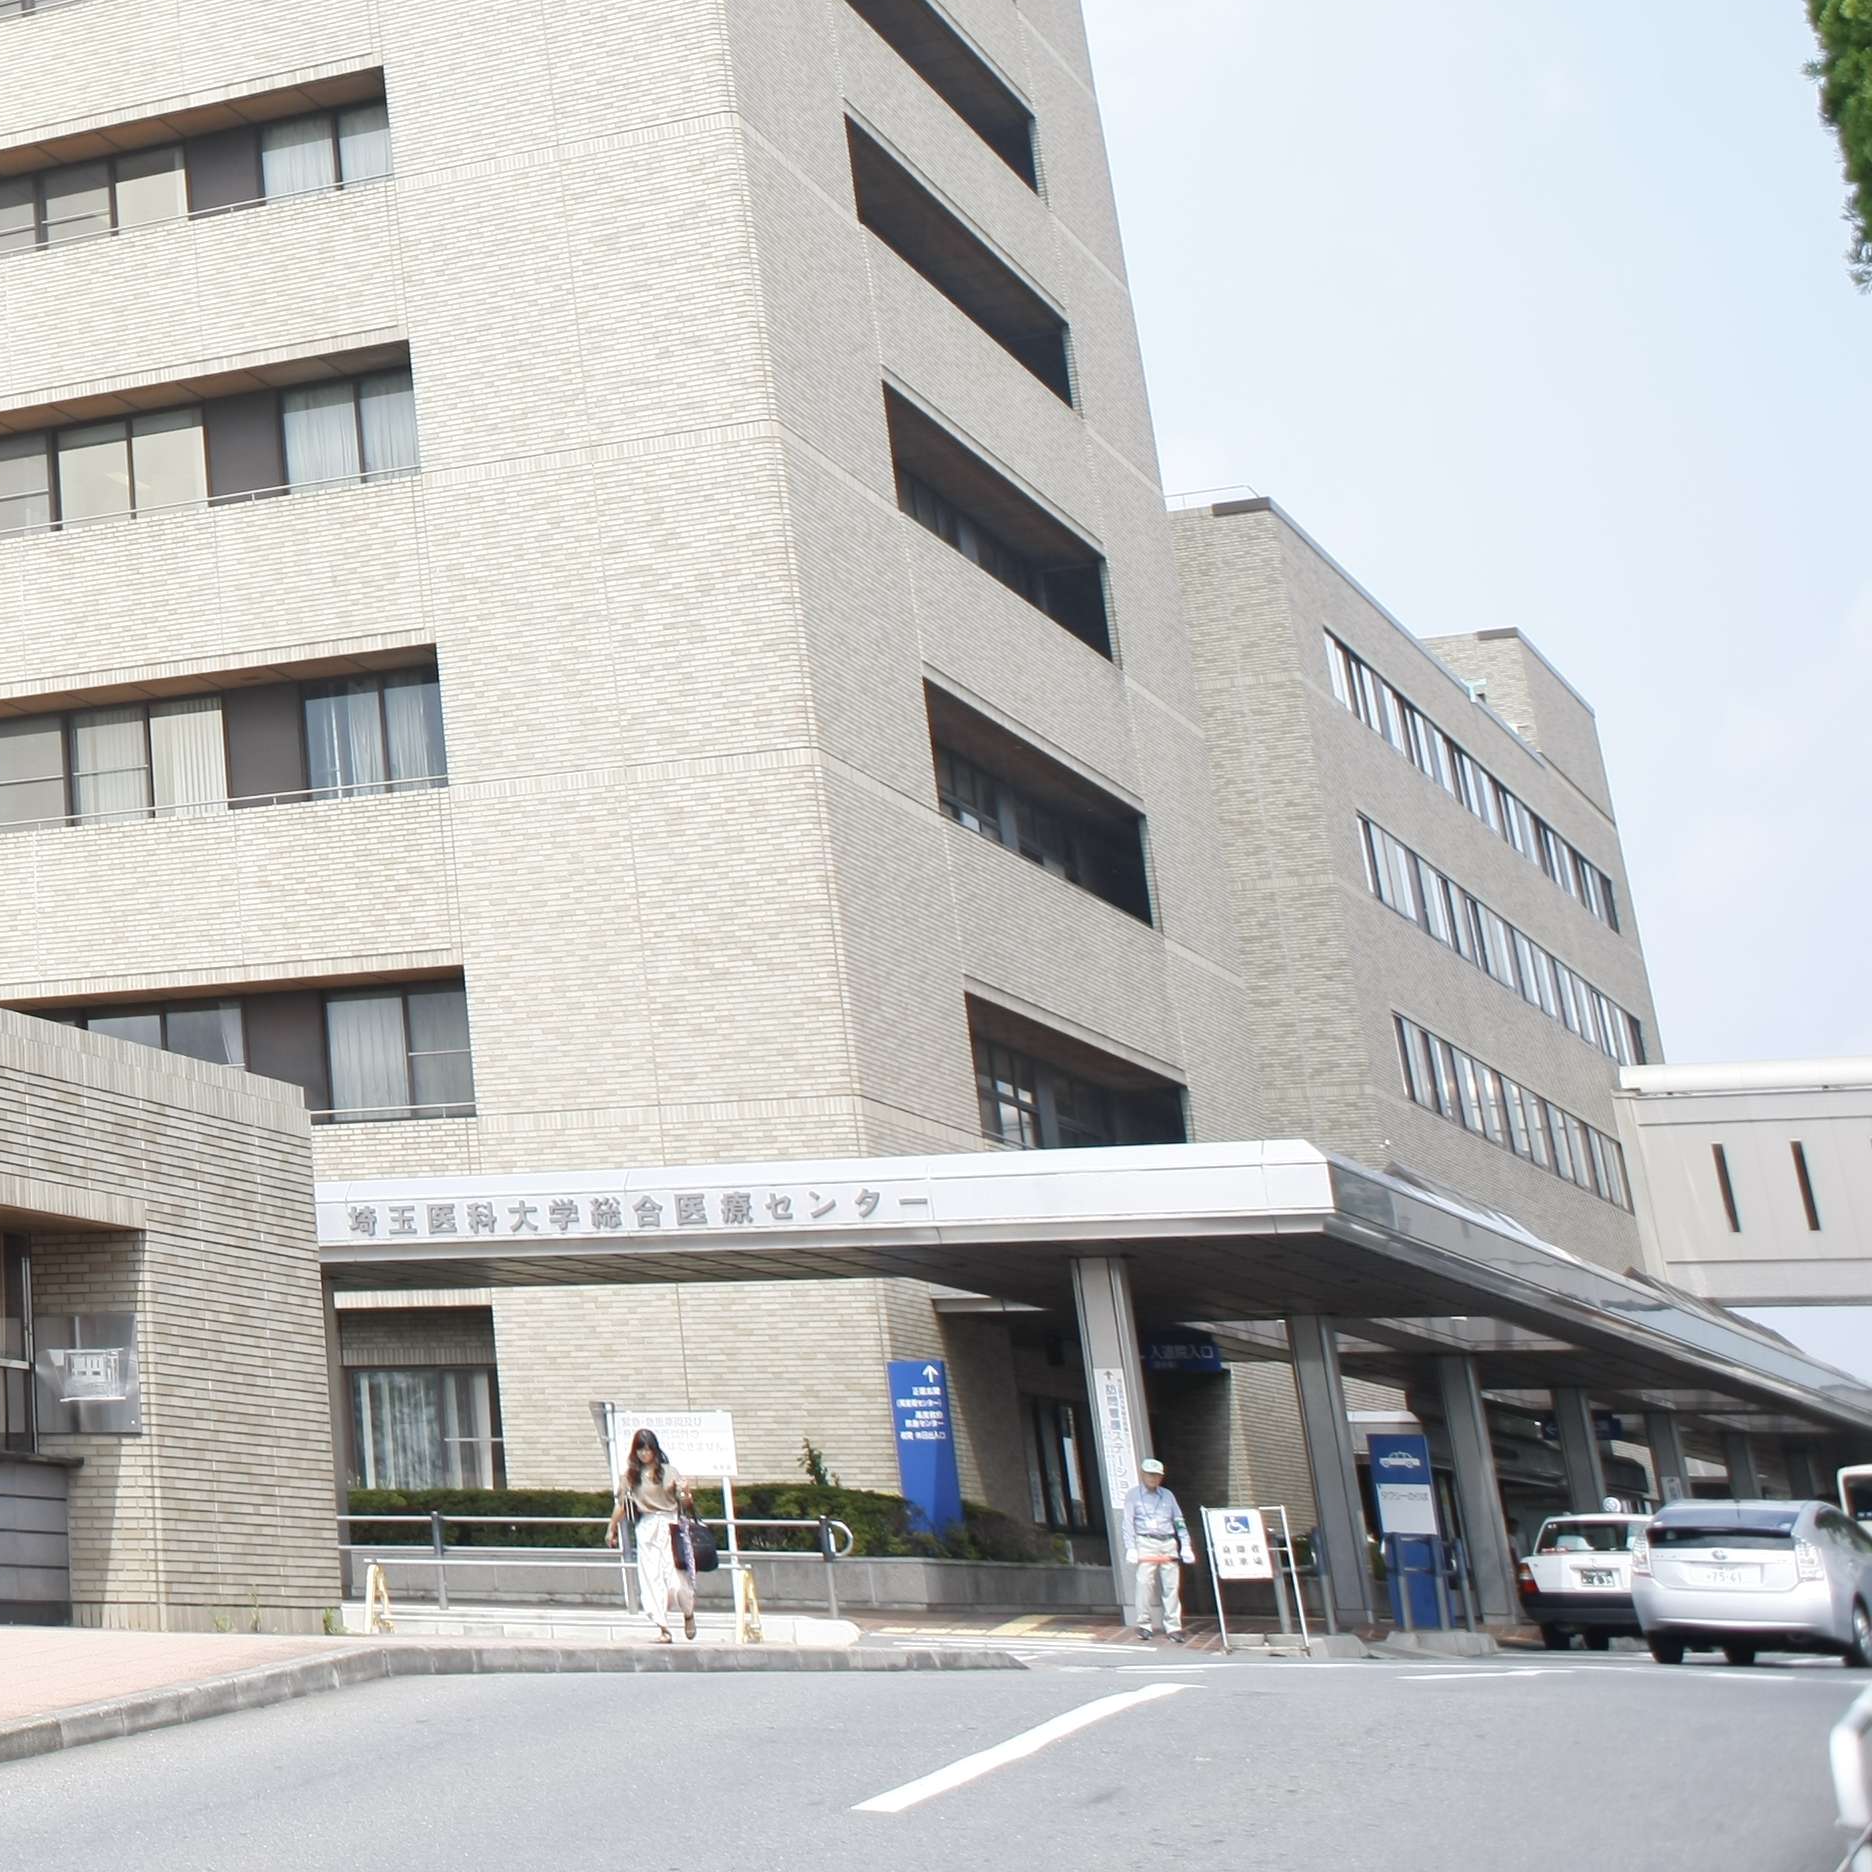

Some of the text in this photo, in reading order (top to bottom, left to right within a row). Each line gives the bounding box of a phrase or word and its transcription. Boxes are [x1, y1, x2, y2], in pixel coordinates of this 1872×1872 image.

[348, 1187, 929, 1238] 埼玉医科大学総合医療センター
